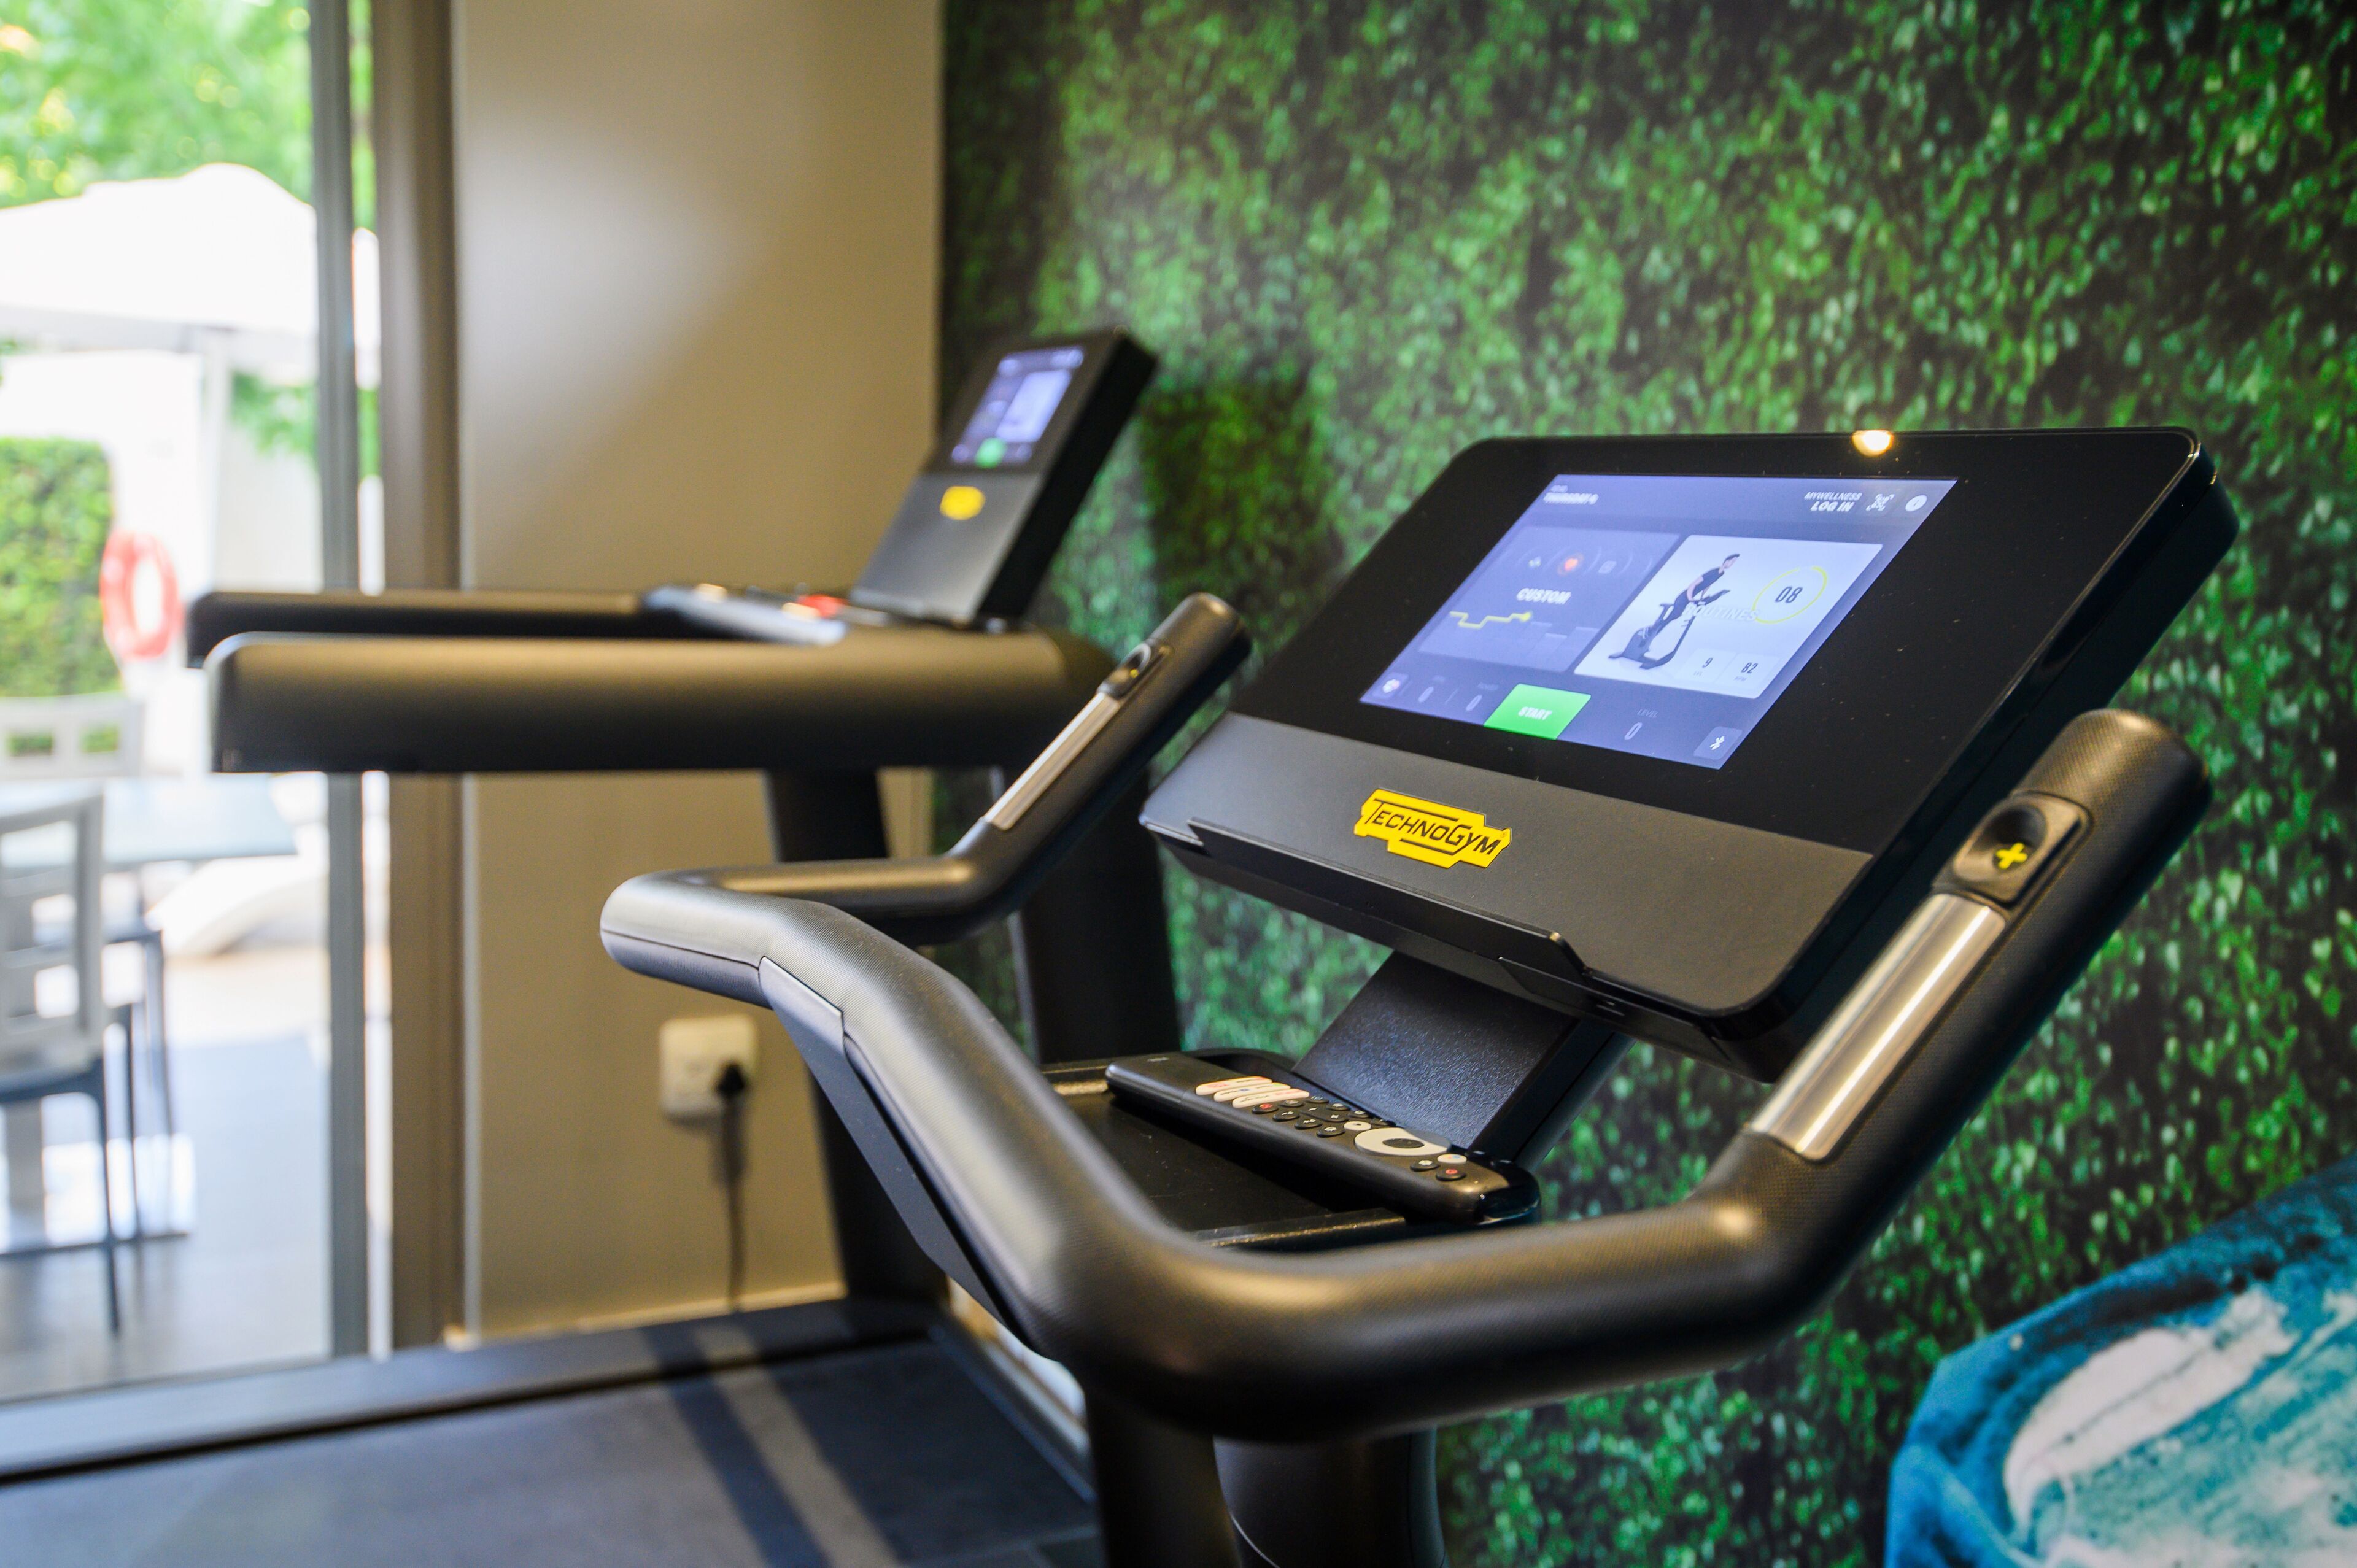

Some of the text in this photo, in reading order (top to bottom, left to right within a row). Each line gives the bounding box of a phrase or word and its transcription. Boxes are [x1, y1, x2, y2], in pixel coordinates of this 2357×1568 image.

[1804, 491, 1862, 500] MYWELLNESS
[1811, 501, 1855, 512] LOG IN
[1517, 588, 1572, 604] CUSTOM
[1775, 586, 1803, 603] 08
[1684, 604, 1759, 620] ROUTINES
[1702, 657, 1713, 668] 9
[1741, 662, 1759, 674] 82
[1518, 706, 1552, 720] START
[1637, 709, 1658, 718] LEVEL
[1624, 722, 1643, 740] 0
[1364, 798, 1502, 856] TECHNOGYM
